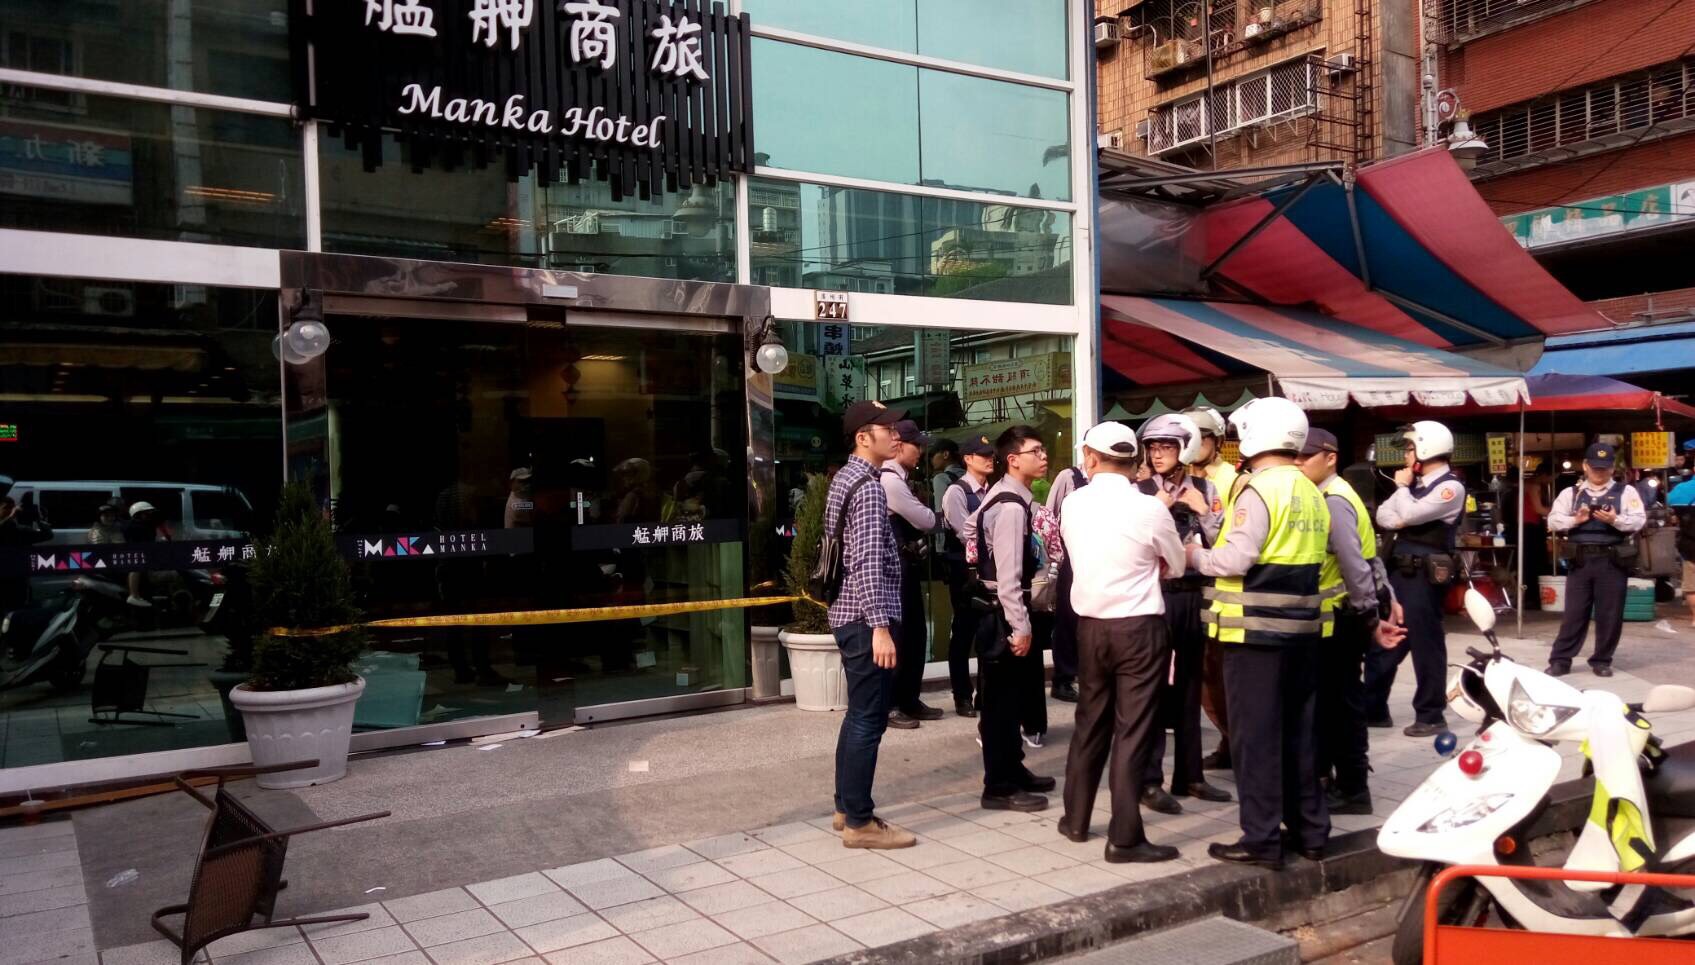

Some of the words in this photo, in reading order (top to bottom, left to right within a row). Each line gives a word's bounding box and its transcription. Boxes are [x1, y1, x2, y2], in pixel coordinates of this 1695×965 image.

[364, 0, 710, 80] 艋舺商旅
[398, 83, 553, 134] Manka
[561, 106, 667, 149] Hotel
[818, 302, 846, 318] 247
[631, 522, 705, 545] 艋舺商旅
[1287, 519, 1325, 533] POLCE
[439, 532, 487, 543] HOTEL
[439, 543, 487, 553] MANKA
